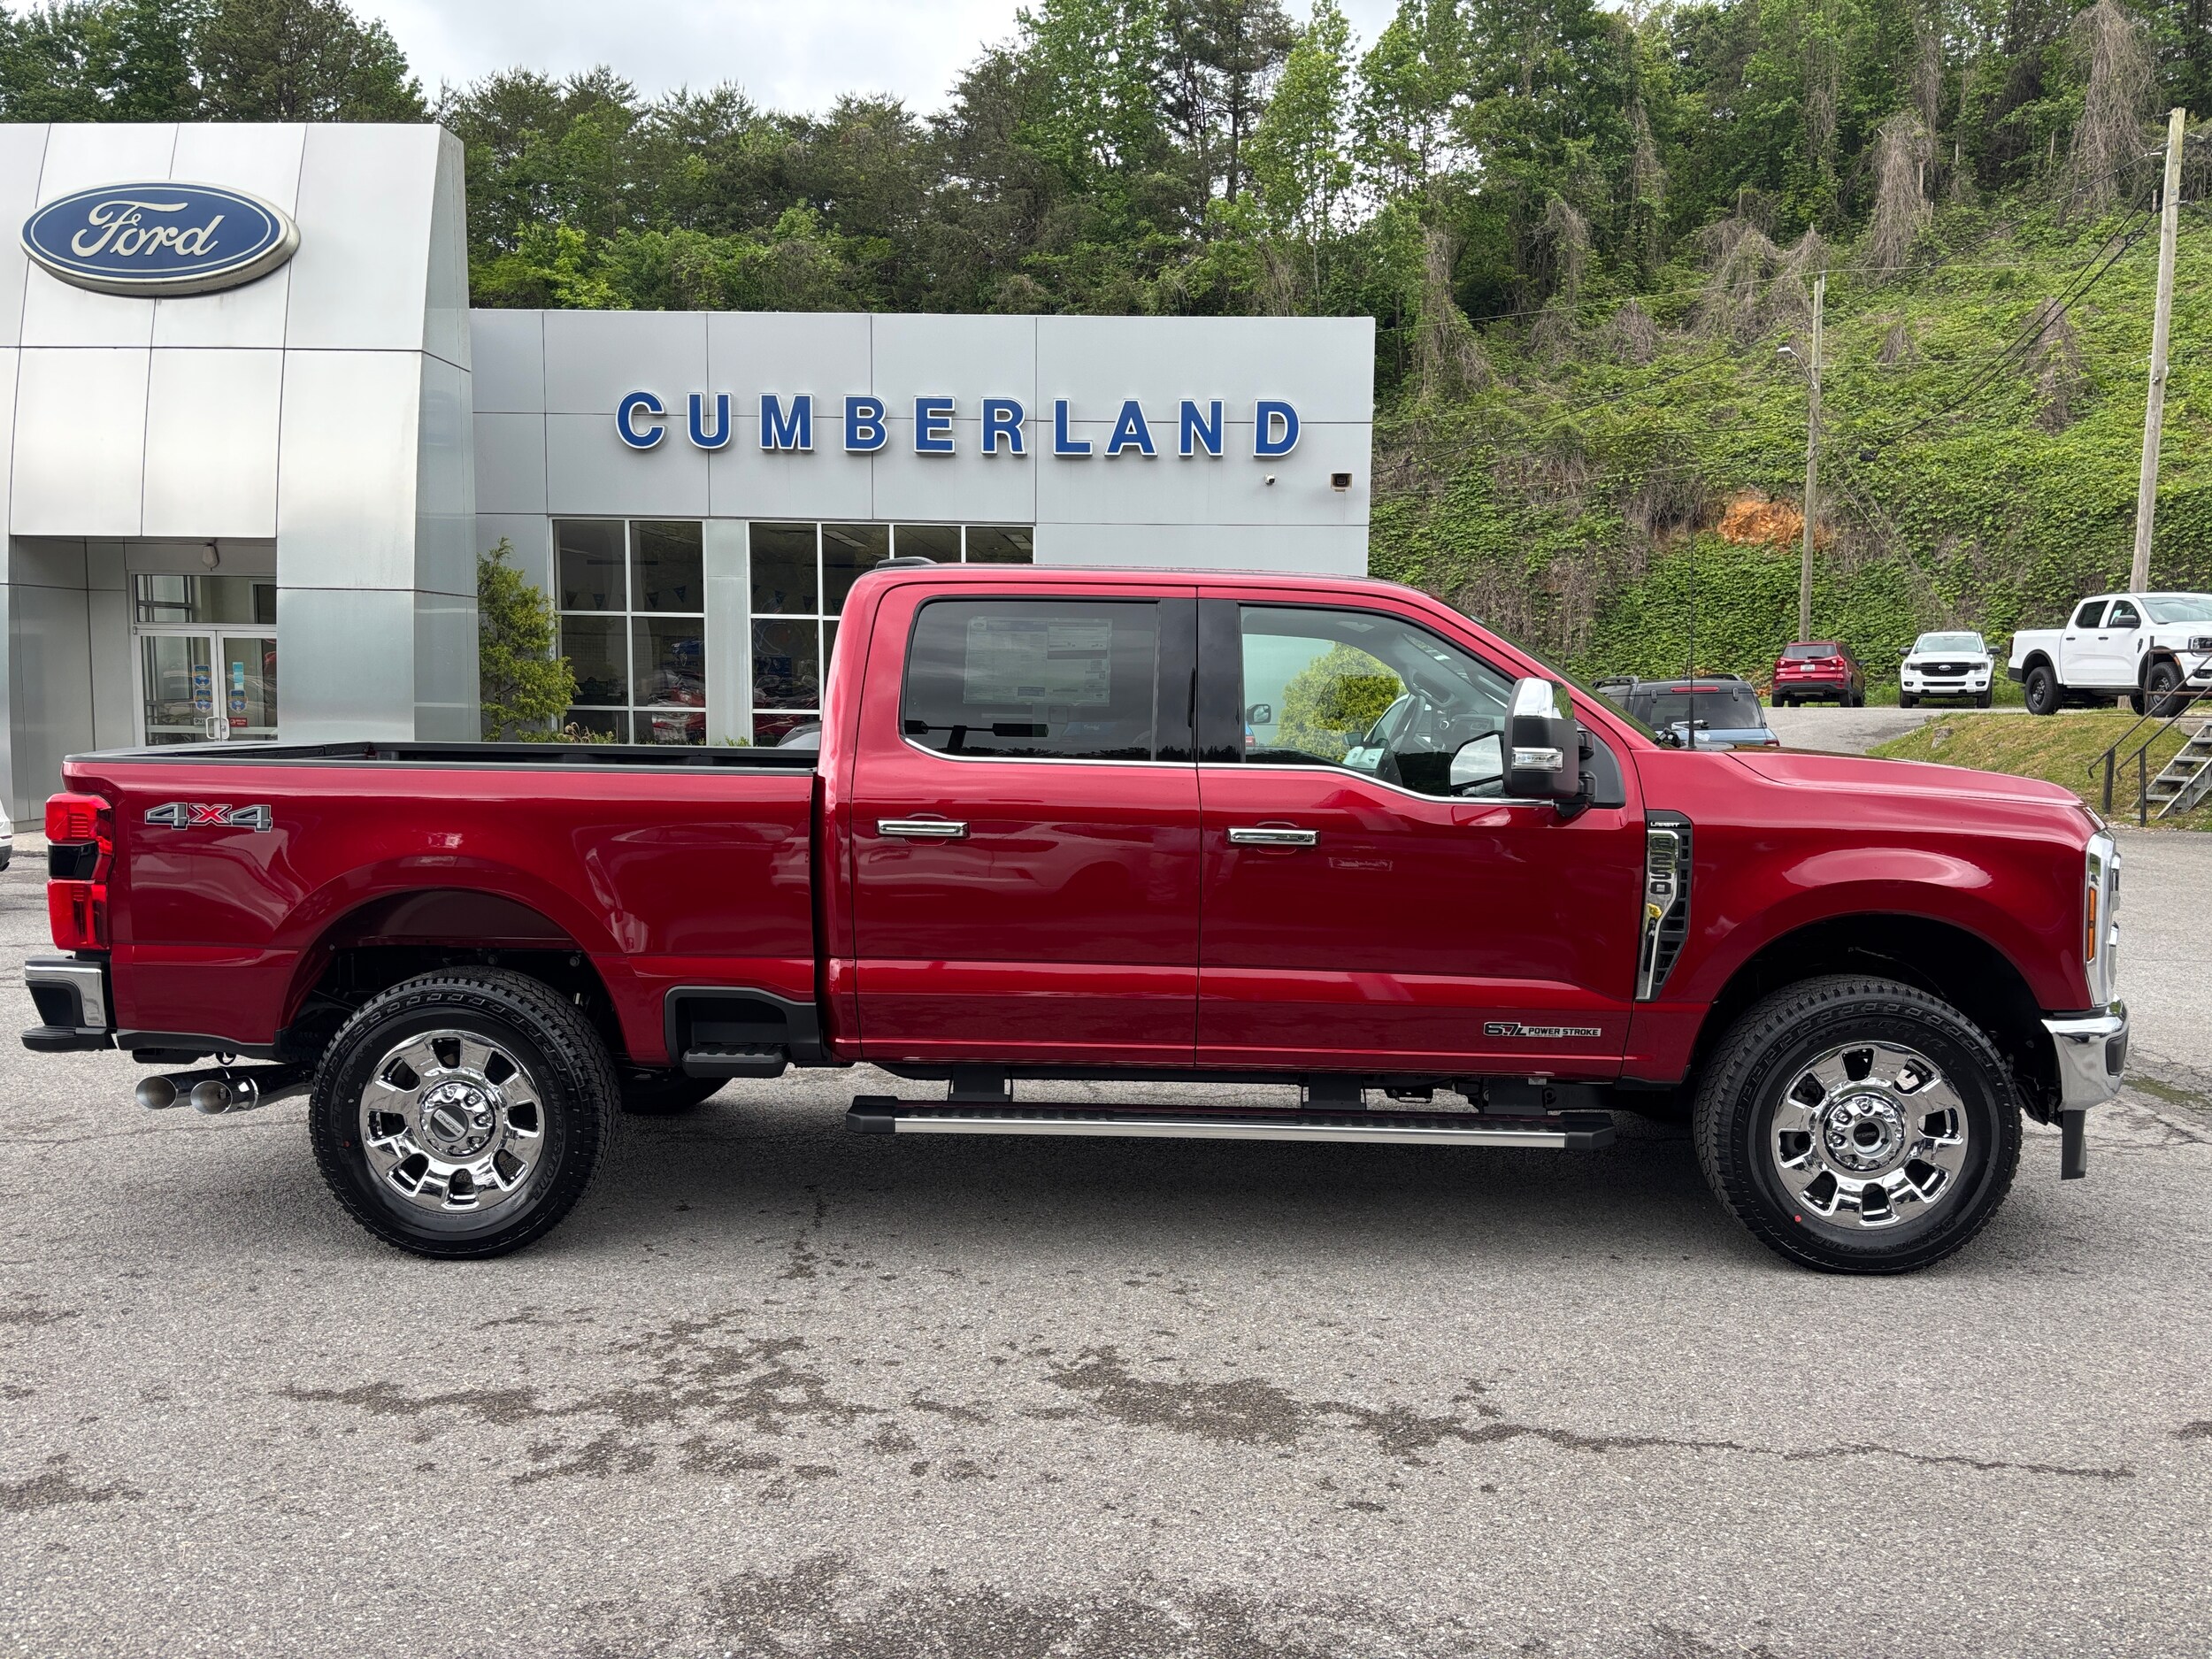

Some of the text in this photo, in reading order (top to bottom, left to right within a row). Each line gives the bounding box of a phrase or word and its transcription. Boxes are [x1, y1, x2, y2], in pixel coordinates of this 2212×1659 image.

[71, 199, 227, 258] Ford
[614, 388, 1303, 459] CUMBERLAND
[1484, 1022, 1527, 1036] 6.7L
[438, 1114, 461, 1133] FORD
